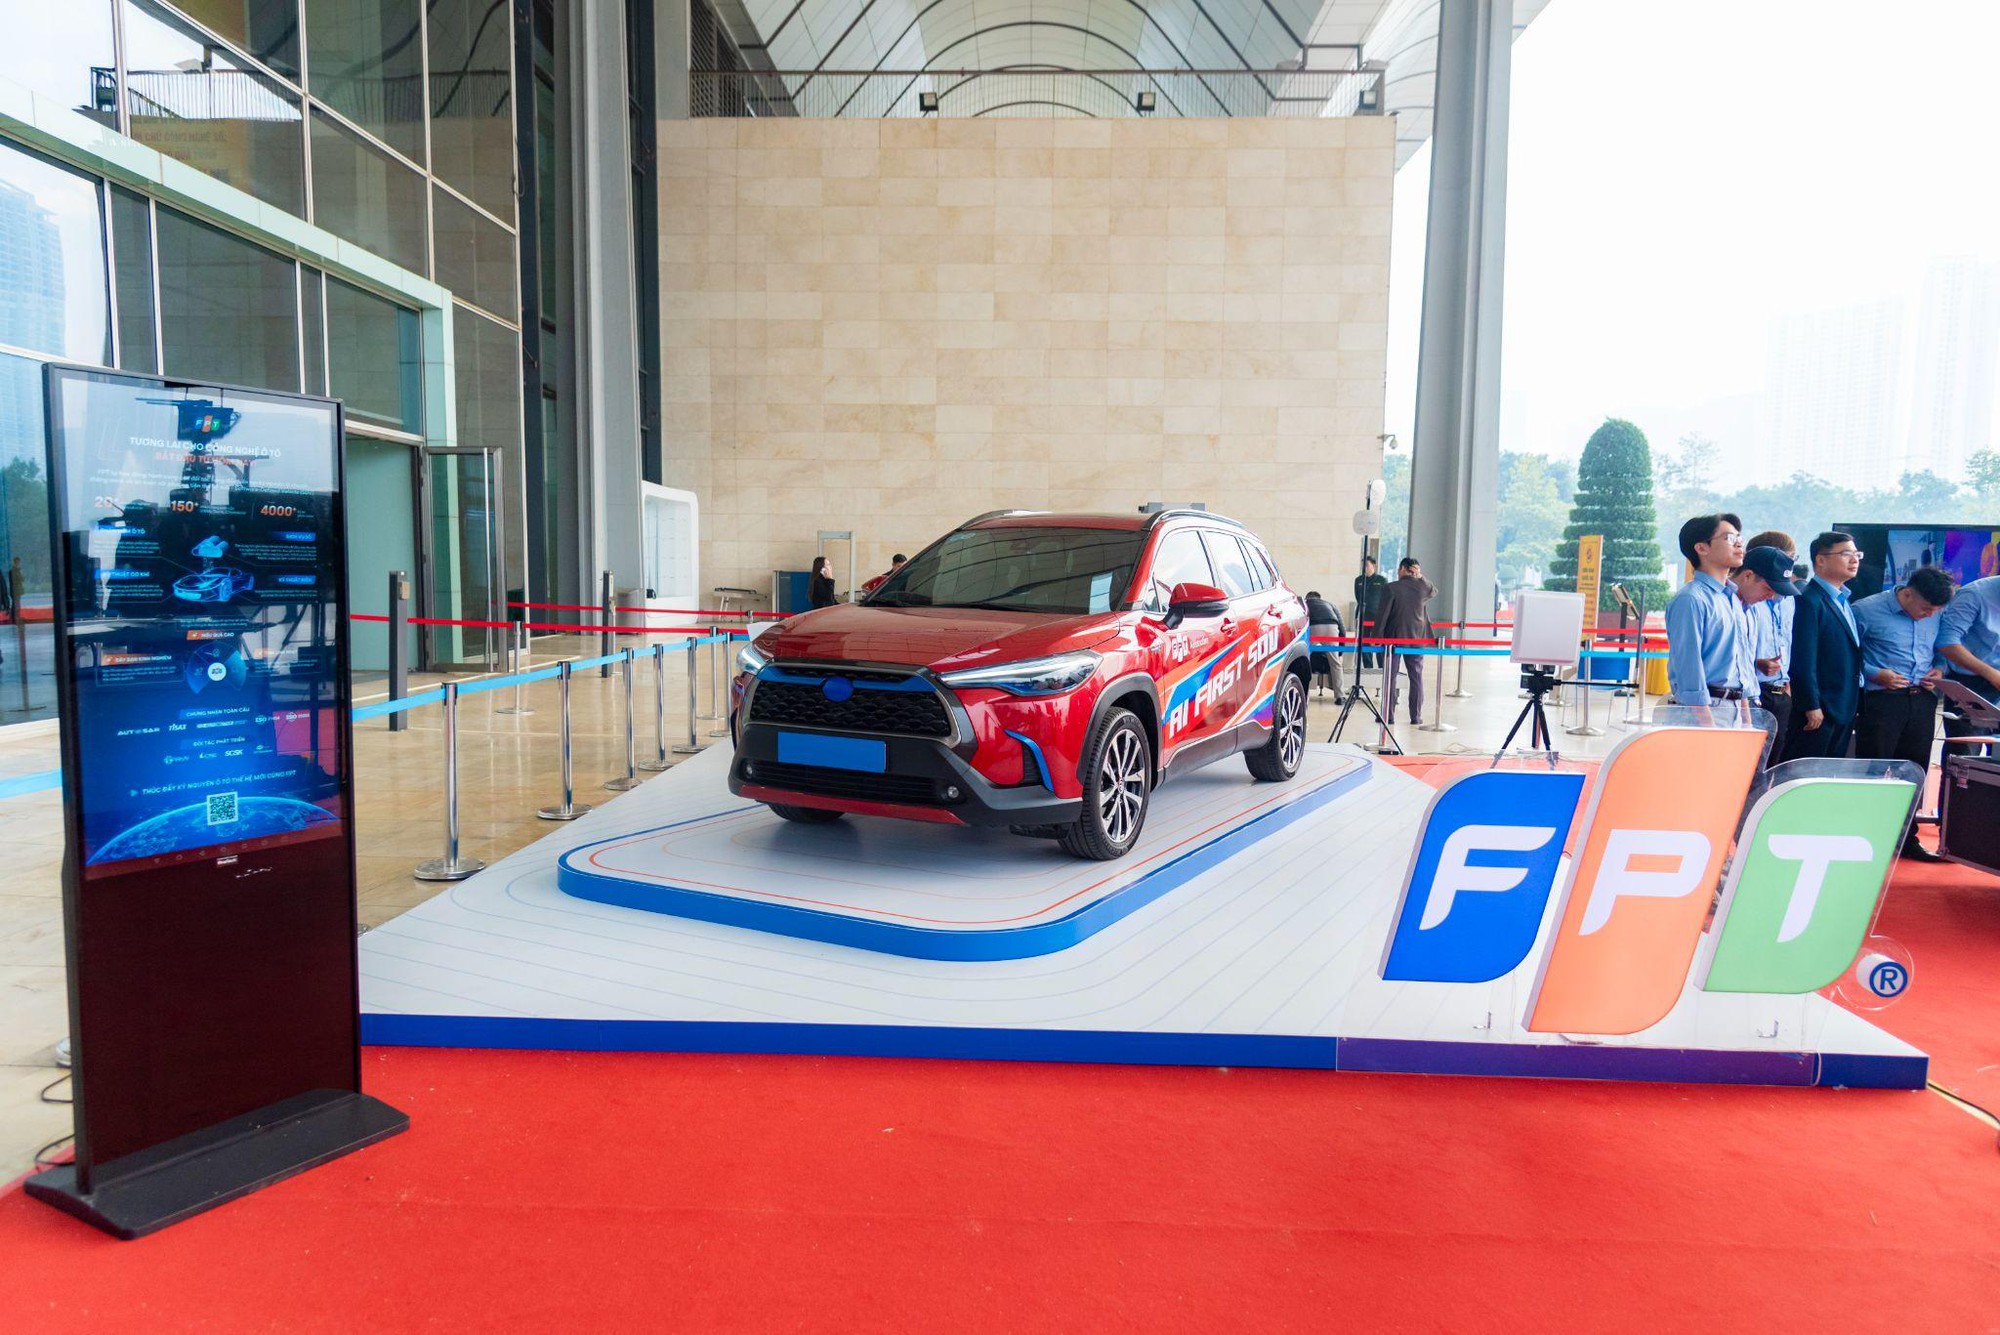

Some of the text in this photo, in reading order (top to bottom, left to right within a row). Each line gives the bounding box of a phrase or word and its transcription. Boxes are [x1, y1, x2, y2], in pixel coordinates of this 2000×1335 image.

[166, 440, 182, 449] LAI
[182, 441, 204, 452] CHO
[205, 442, 234, 454] CÔNG
[269, 448, 281, 458] TÔ
[171, 500, 200, 512] 150+
[260, 504, 296, 516] 4000+
[1169, 698, 1189, 738] AI
[1194, 652, 1244, 718] FIRST
[1419, 824, 1873, 943] FPT
